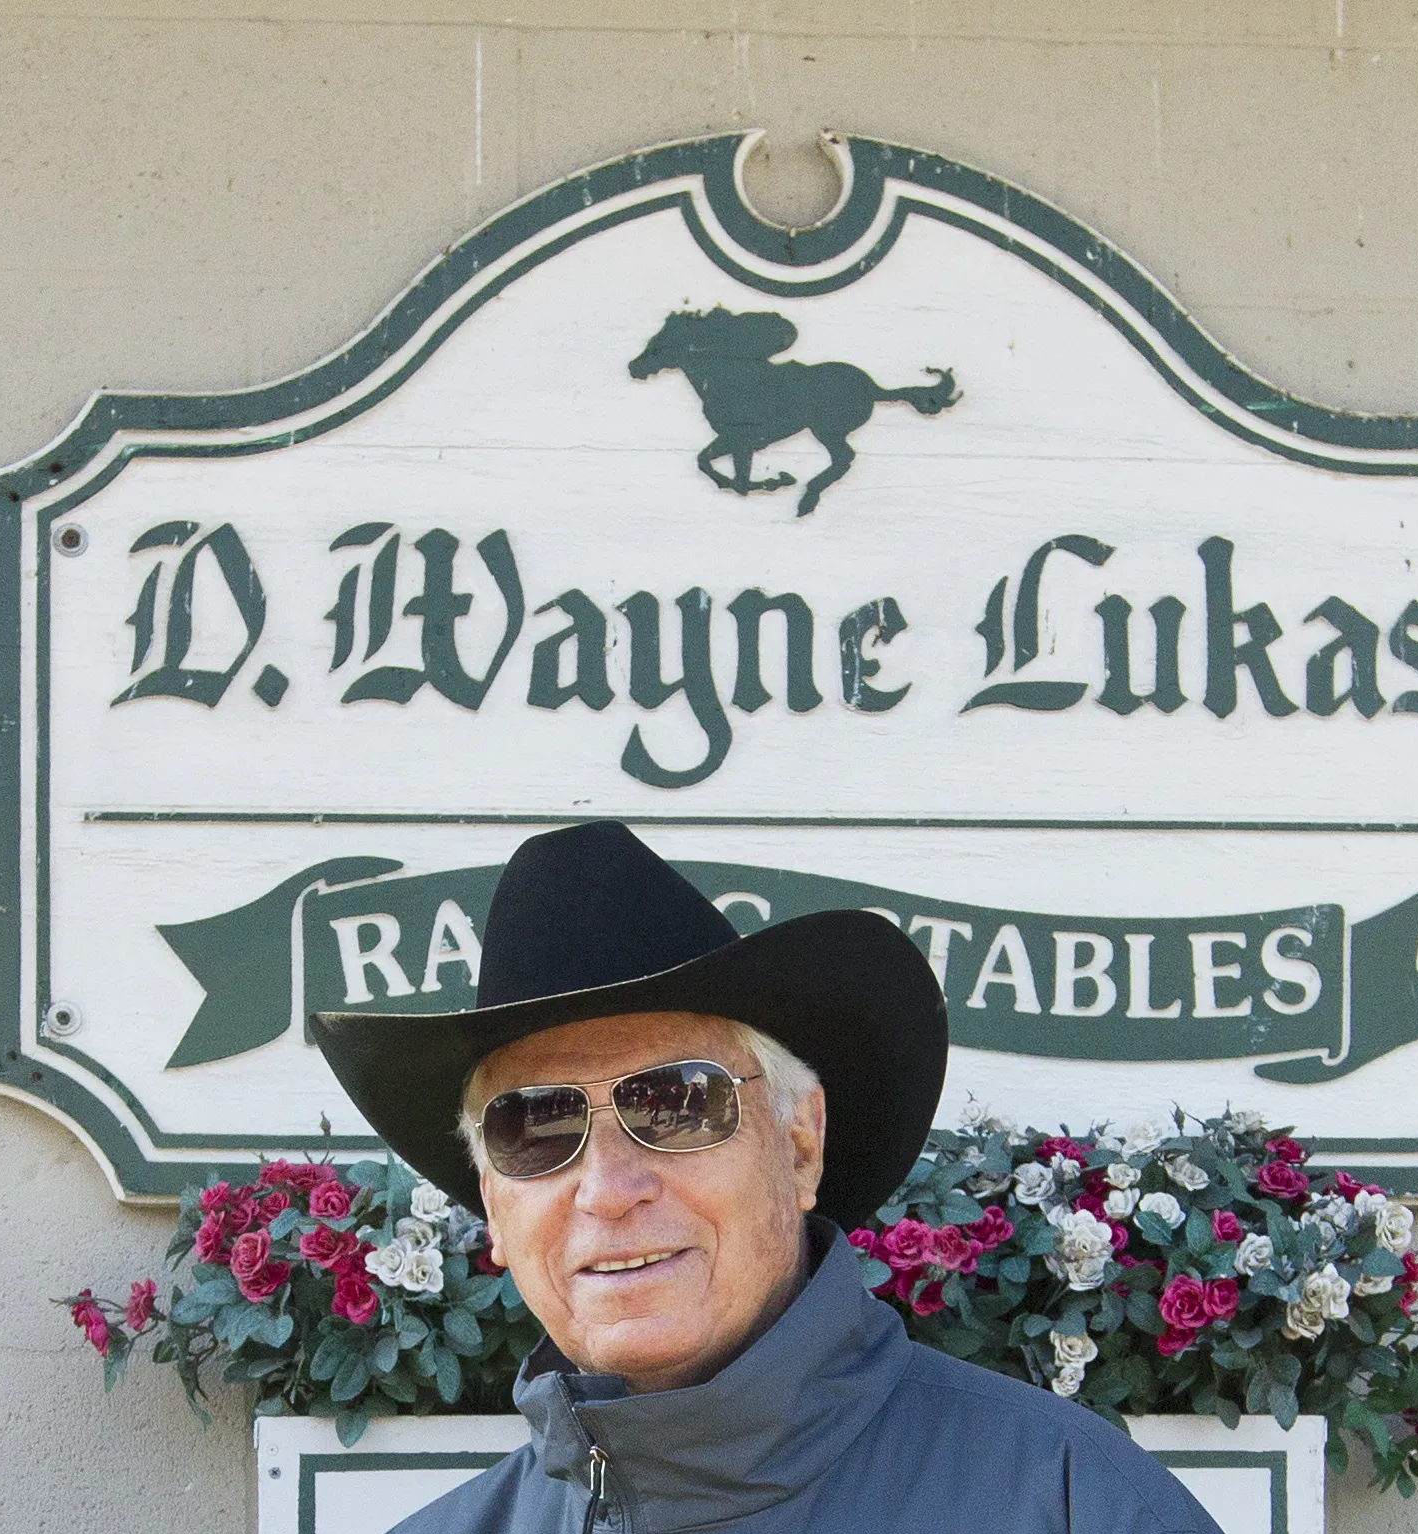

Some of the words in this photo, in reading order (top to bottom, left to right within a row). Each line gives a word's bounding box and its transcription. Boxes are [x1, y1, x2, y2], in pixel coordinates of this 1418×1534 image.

[109, 519, 290, 710] D.
[322, 521, 913, 791] Wayne
[859, 906, 1322, 1019] TABLES
